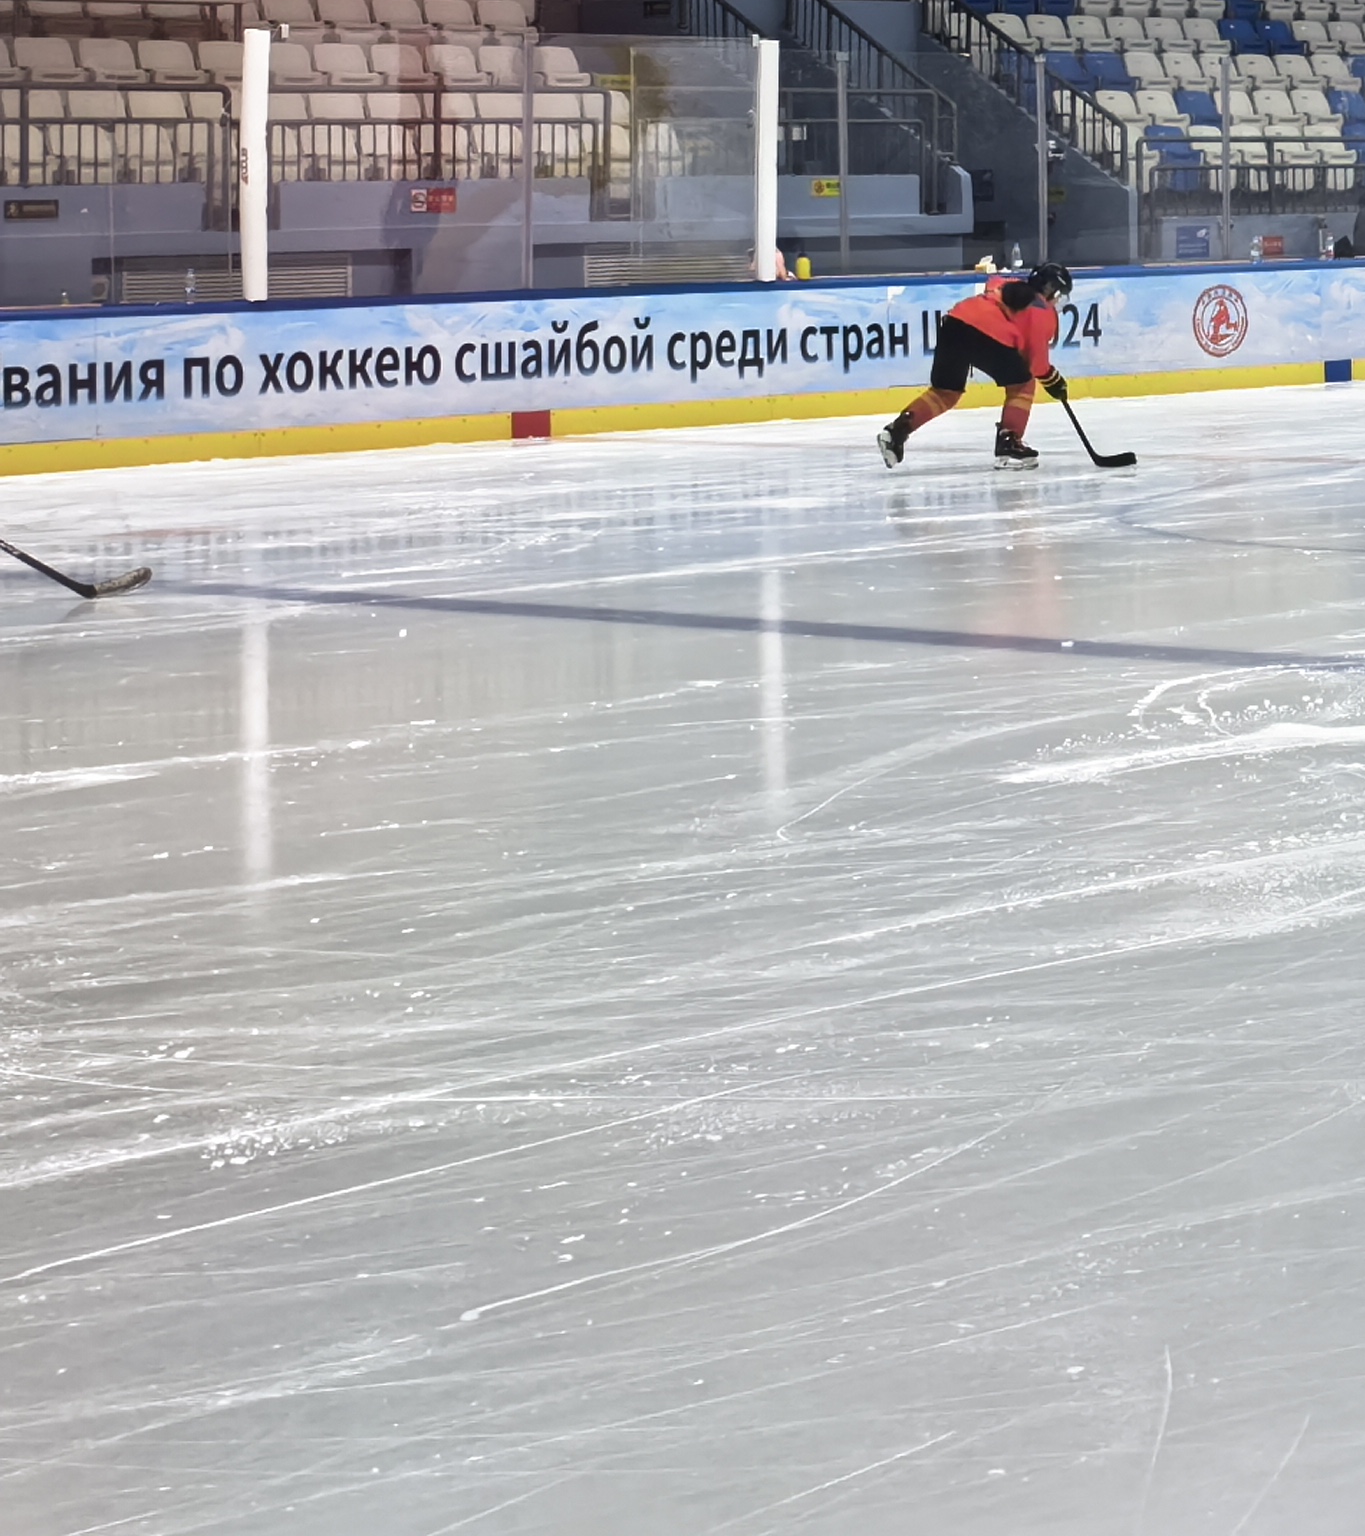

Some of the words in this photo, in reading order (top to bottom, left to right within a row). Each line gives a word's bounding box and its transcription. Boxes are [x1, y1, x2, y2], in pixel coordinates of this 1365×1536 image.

[3, 359, 164, 410] вания
[183, 354, 244, 398] по
[260, 344, 441, 394] хоккею
[668, 328, 787, 382] среди
[800, 322, 909, 373] стран
